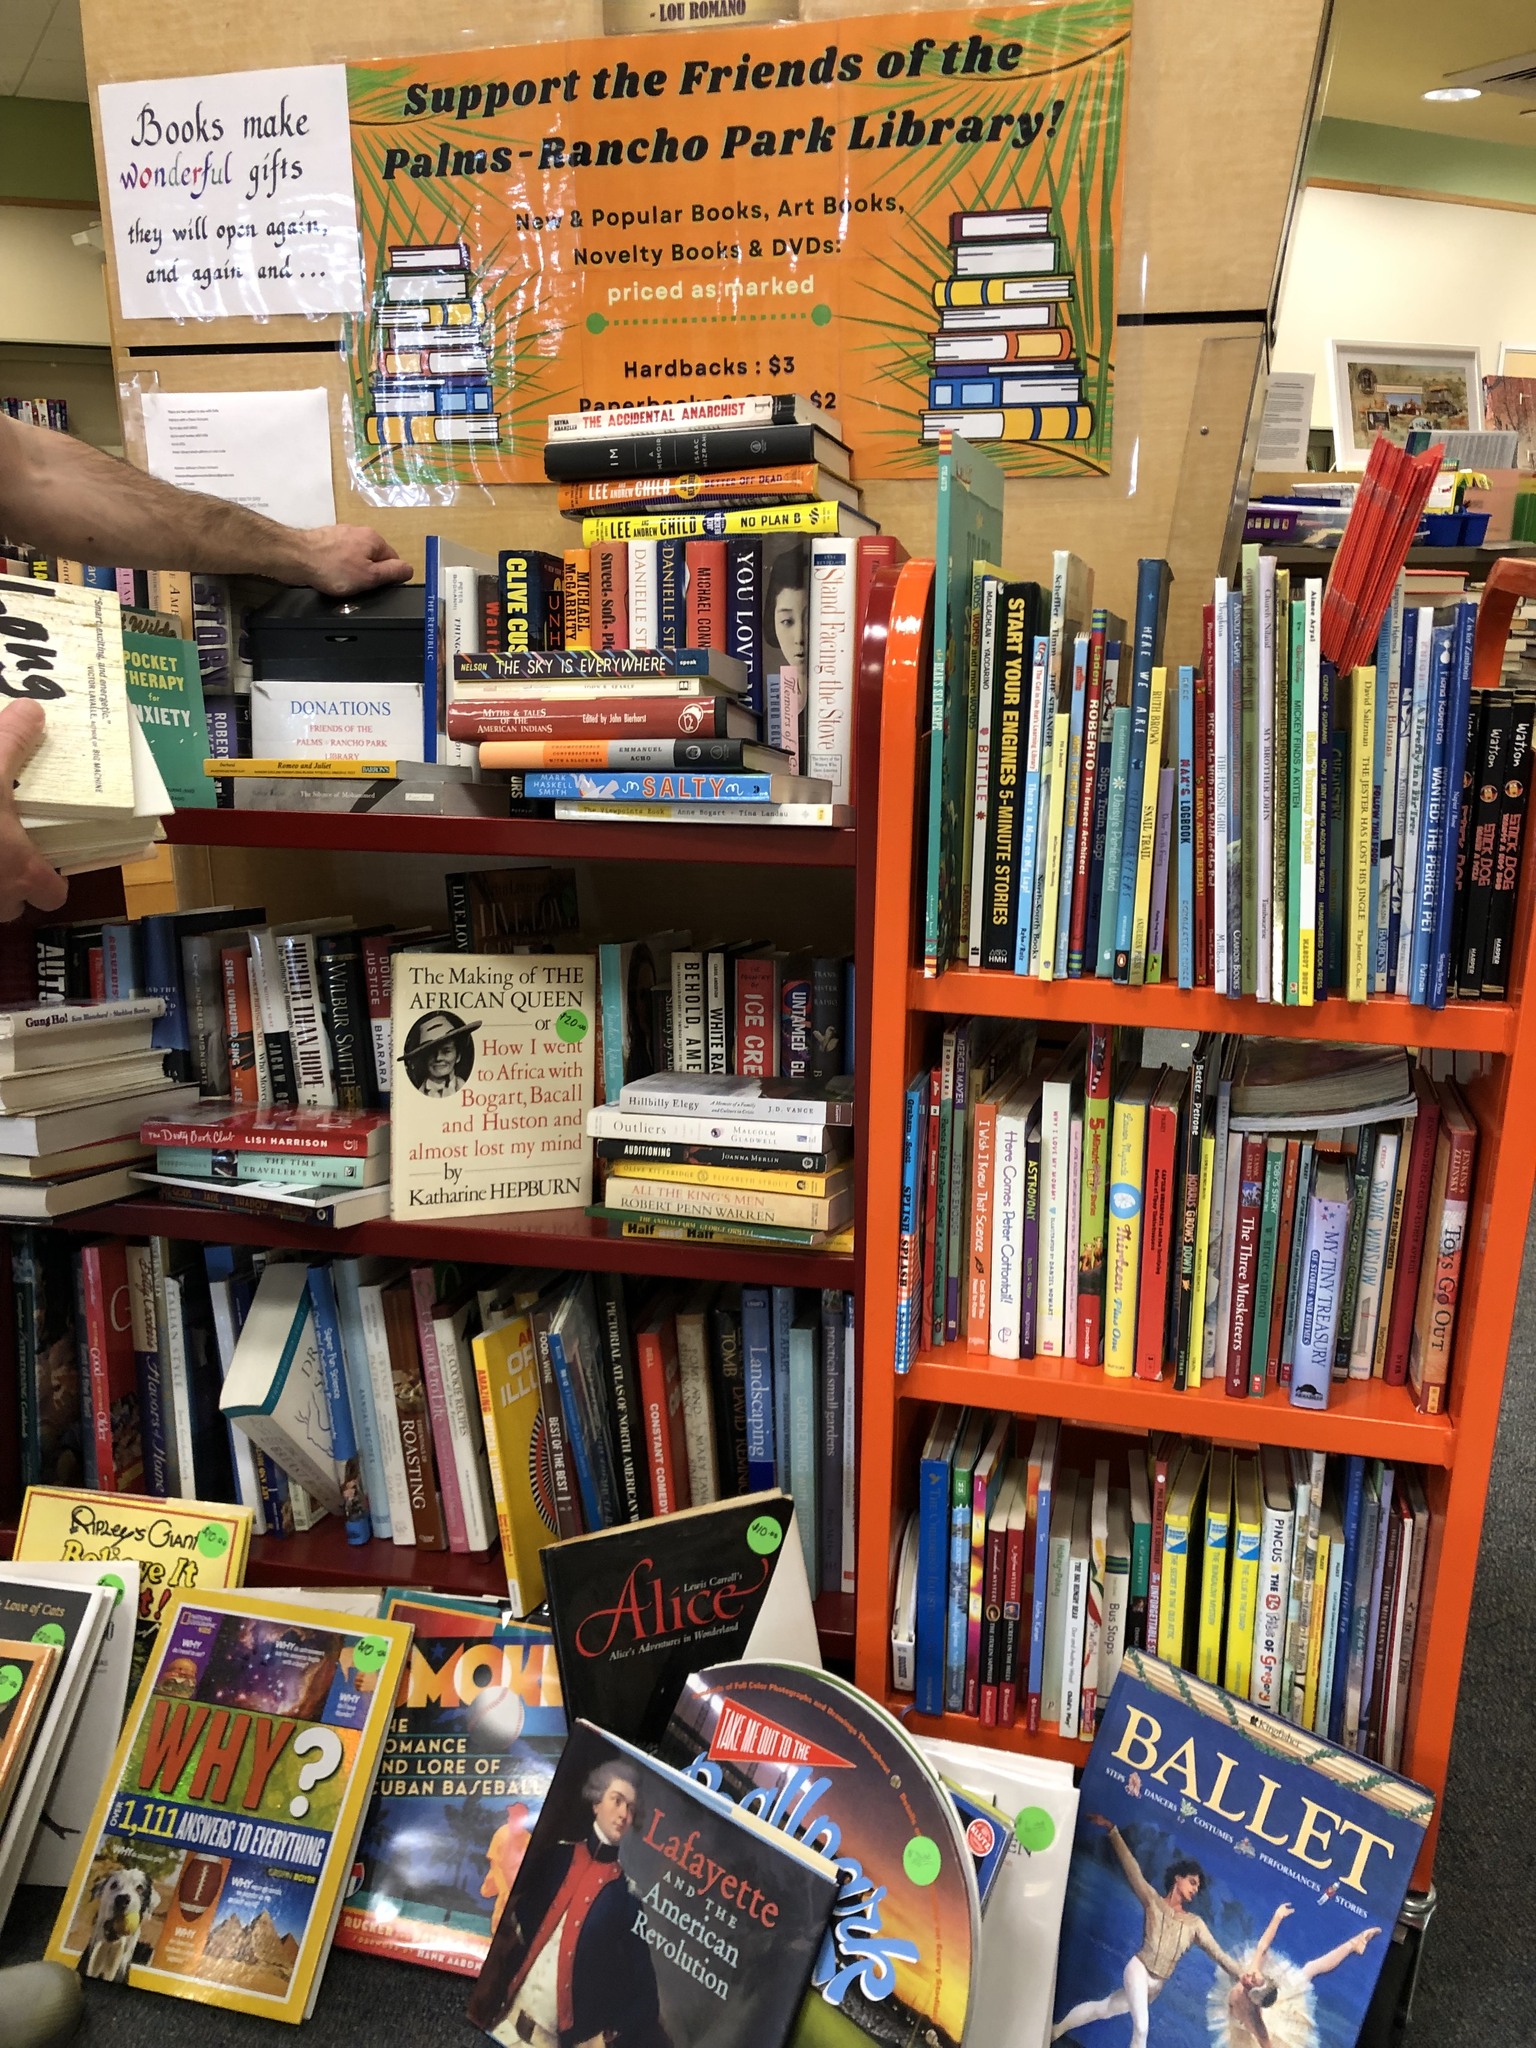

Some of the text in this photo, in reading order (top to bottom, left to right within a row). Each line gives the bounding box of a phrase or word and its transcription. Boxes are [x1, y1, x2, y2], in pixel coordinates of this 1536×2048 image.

[660, 0, 746, 22] LOU ROMANO
[404, 35, 1024, 120] Support the Friends of the
[131, 95, 310, 147] Books make
[382, 100, 1065, 181] Palms-Rancho Park Library!
[120, 149, 304, 200] wonderful gifts
[516, 193, 905, 231] New & Popular Books, Art Books,
[128, 214, 257, 256] they will open
[574, 237, 842, 268] Novelty Books & DVDs:
[146, 254, 292, 293] and again and
[608, 275, 815, 306] priced as marked
[625, 355, 796, 379] Hardbacks $3
[583, 402, 746, 429] THE ACCIDENTAL ANARCHIST
[811, 391, 838, 413] $2
[589, 479, 670, 501] LEE CHILD
[611, 513, 789, 540] LEE ANDREW CHILD NO PLAN
[506, 557, 528, 614] CLIVE
[635, 549, 647, 623] DANIELLE
[662, 547, 675, 622] DANIELLE
[697, 567, 711, 615] MICHAEL
[736, 551, 754, 602] YOU
[565, 563, 577, 641] McGARRITY
[578, 571, 590, 632] MICHAEL
[124, 650, 178, 672] POCKET
[460, 657, 666, 675] NELSON THE SKY IS EVERYWHERE
[814, 567, 846, 750] Stand Facing the Stove
[291, 700, 391, 716] DONATIONS
[624, 713, 647, 723] Bierhorst
[310, 724, 343, 733] FRIENDS
[331, 738, 387, 747] RANCHO PARK
[477, 724, 553, 733] AMERICAN INDIANS
[1084, 699, 1099, 771] ROBERTO
[1513, 722, 1530, 768] Watson
[992, 597, 1026, 925] START YOUR ENGINES 5-MINUTE STORIES
[533, 781, 573, 789] HASKELL
[642, 776, 726, 798] SALTY
[1422, 854, 1436, 907] PERFECT
[409, 966, 584, 990] The Making of THE
[409, 991, 583, 1013] AFRICAN QUEEN
[534, 1017, 551, 1031] or
[482, 1038, 583, 1057] How I went
[477, 1062, 583, 1081] to Africa with
[461, 1084, 582, 1113] Bogart, Bacall
[629, 1096, 669, 1110] Hillbilly
[672, 1097, 700, 1111] Elegy
[442, 1109, 582, 1134] and Huston and
[613, 1120, 667, 1136] Outliers
[244, 1136, 328, 1148] LISI HARRISON
[409, 1133, 582, 1161] almost lost my mind
[623, 1144, 671, 1158] AUDITIONING
[444, 1162, 463, 1185] by
[1002, 1131, 1017, 1242] Here Comes Peter
[409, 1177, 581, 1207] Katharine HEPBURN
[631, 1184, 765, 1207] ALL THE KING'S MEN
[1026, 1160, 1038, 1221] ASTRONOMY
[621, 1196, 775, 1222] ROBERT PENN WARREN
[1233, 1216, 1255, 1351] The Three Musketeers
[1311, 1230, 1340, 1368] MY TINY TREASURY
[575, 1557, 770, 1658] Alice
[637, 1622, 739, 1656] Adventures Wonderland
[716, 1707, 811, 1761] TAKE ME OUT TO THE
[138, 1700, 343, 1818] WHY?
[442, 1780, 544, 1796] BASEBALL
[1111, 1703, 1396, 1896] BALLET
[118, 1799, 326, 1868] 1,111 ANSWERS EVERYTHING
[1105, 1766, 1369, 1919] STEPS DANCERS COSTUMES PERFORMANCES STORIES
[642, 1807, 780, 1929] Lafayette
[643, 1886, 739, 1969] American
[631, 1912, 731, 2001] Revolution
